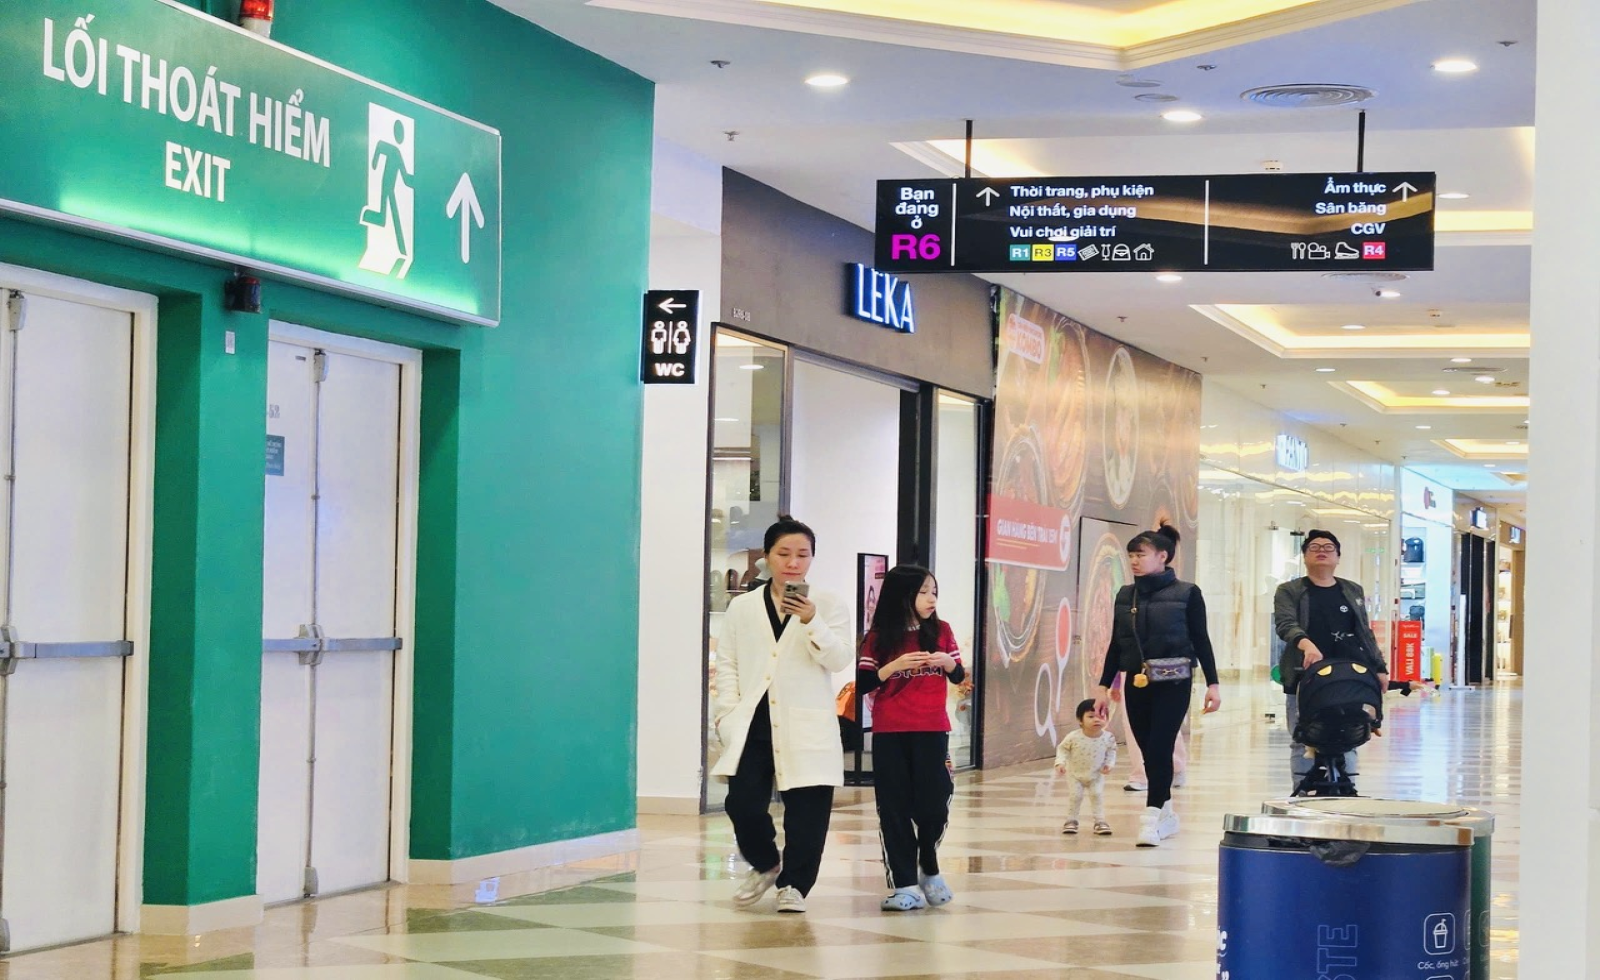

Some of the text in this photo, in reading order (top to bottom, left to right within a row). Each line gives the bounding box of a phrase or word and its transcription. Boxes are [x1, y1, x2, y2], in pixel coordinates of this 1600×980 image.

[43, 14, 331, 168] LỐI THOÁT HIỂM
[165, 141, 231, 203] EXIT
[1010, 184, 1154, 200] Thời trang, phụ kiện
[1324, 177, 1386, 196] Ẩm thực
[900, 187, 935, 203] Bạn
[895, 202, 939, 217] đang
[1010, 203, 1137, 218] Nội thất, gia dụng
[1315, 202, 1387, 216] Sân băng
[911, 217, 922, 230] ở
[1351, 223, 1386, 235] CGV
[1010, 226, 1033, 238] Vui
[1070, 226, 1098, 240] giải
[1099, 226, 1116, 238] trí
[891, 234, 942, 260] R6
[1012, 246, 1075, 258] R1 R3 R5
[1364, 245, 1384, 256] R4
[857, 262, 914, 332] LEKA
[655, 362, 685, 377] WC
